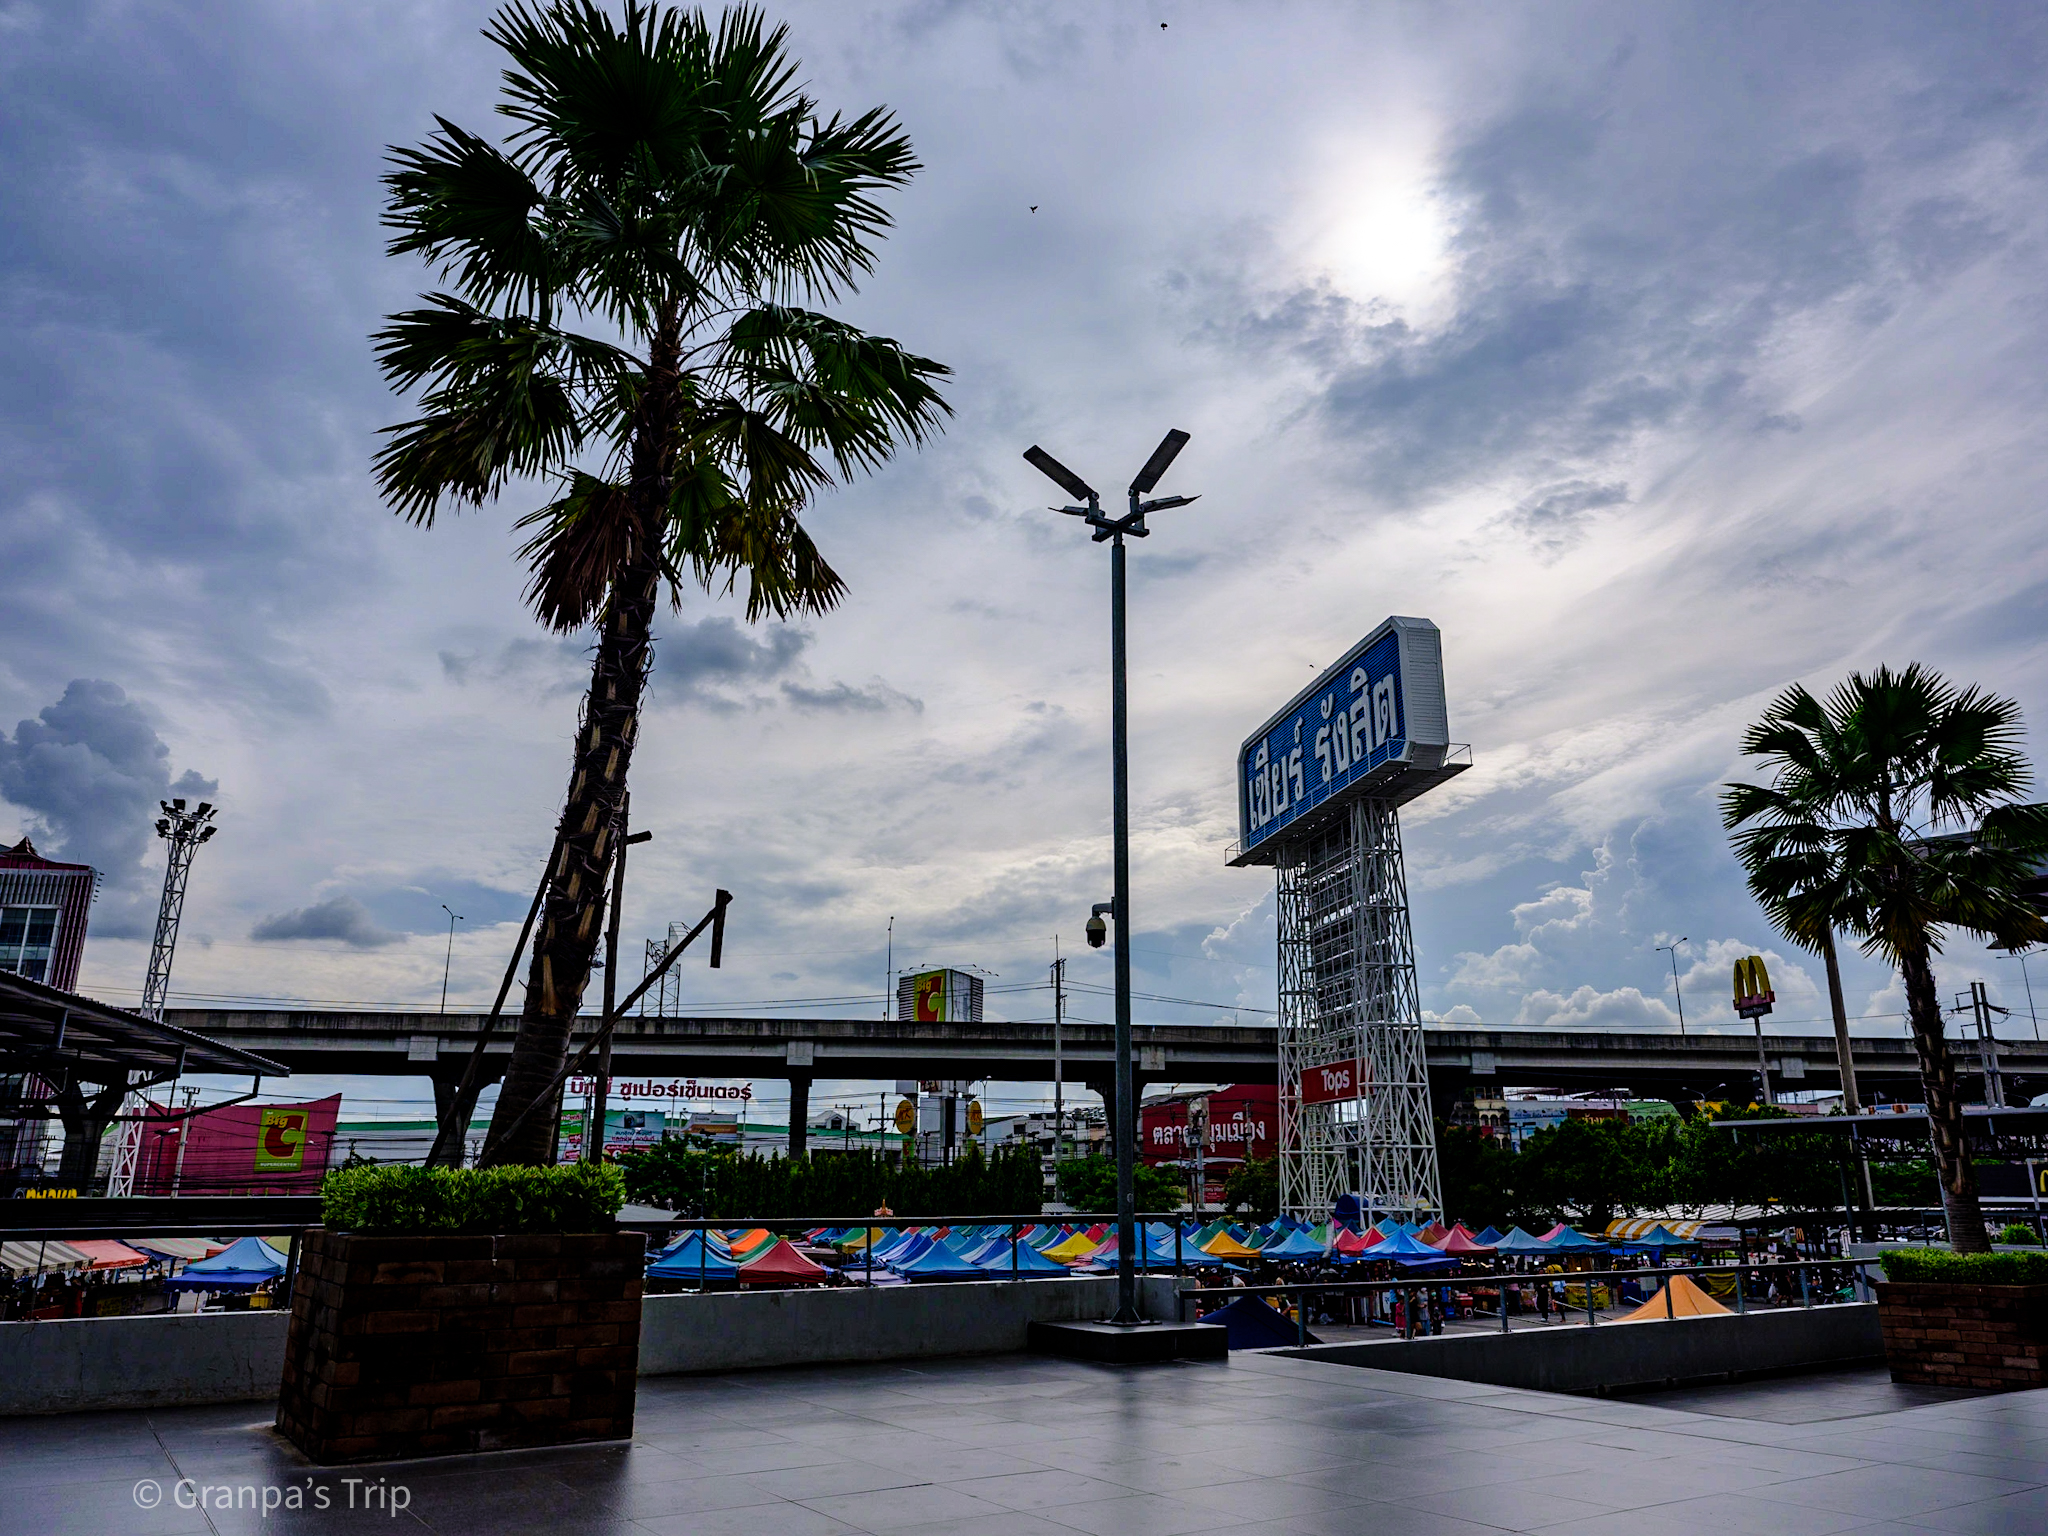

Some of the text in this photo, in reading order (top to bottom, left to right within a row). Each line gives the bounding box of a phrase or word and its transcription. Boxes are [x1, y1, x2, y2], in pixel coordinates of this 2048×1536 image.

[1248, 666, 1399, 831] เซียร์ รังสิต
[917, 980, 932, 993] Big
[1321, 1069, 1350, 1096] Tops
[265, 1115, 306, 1159] Big C
